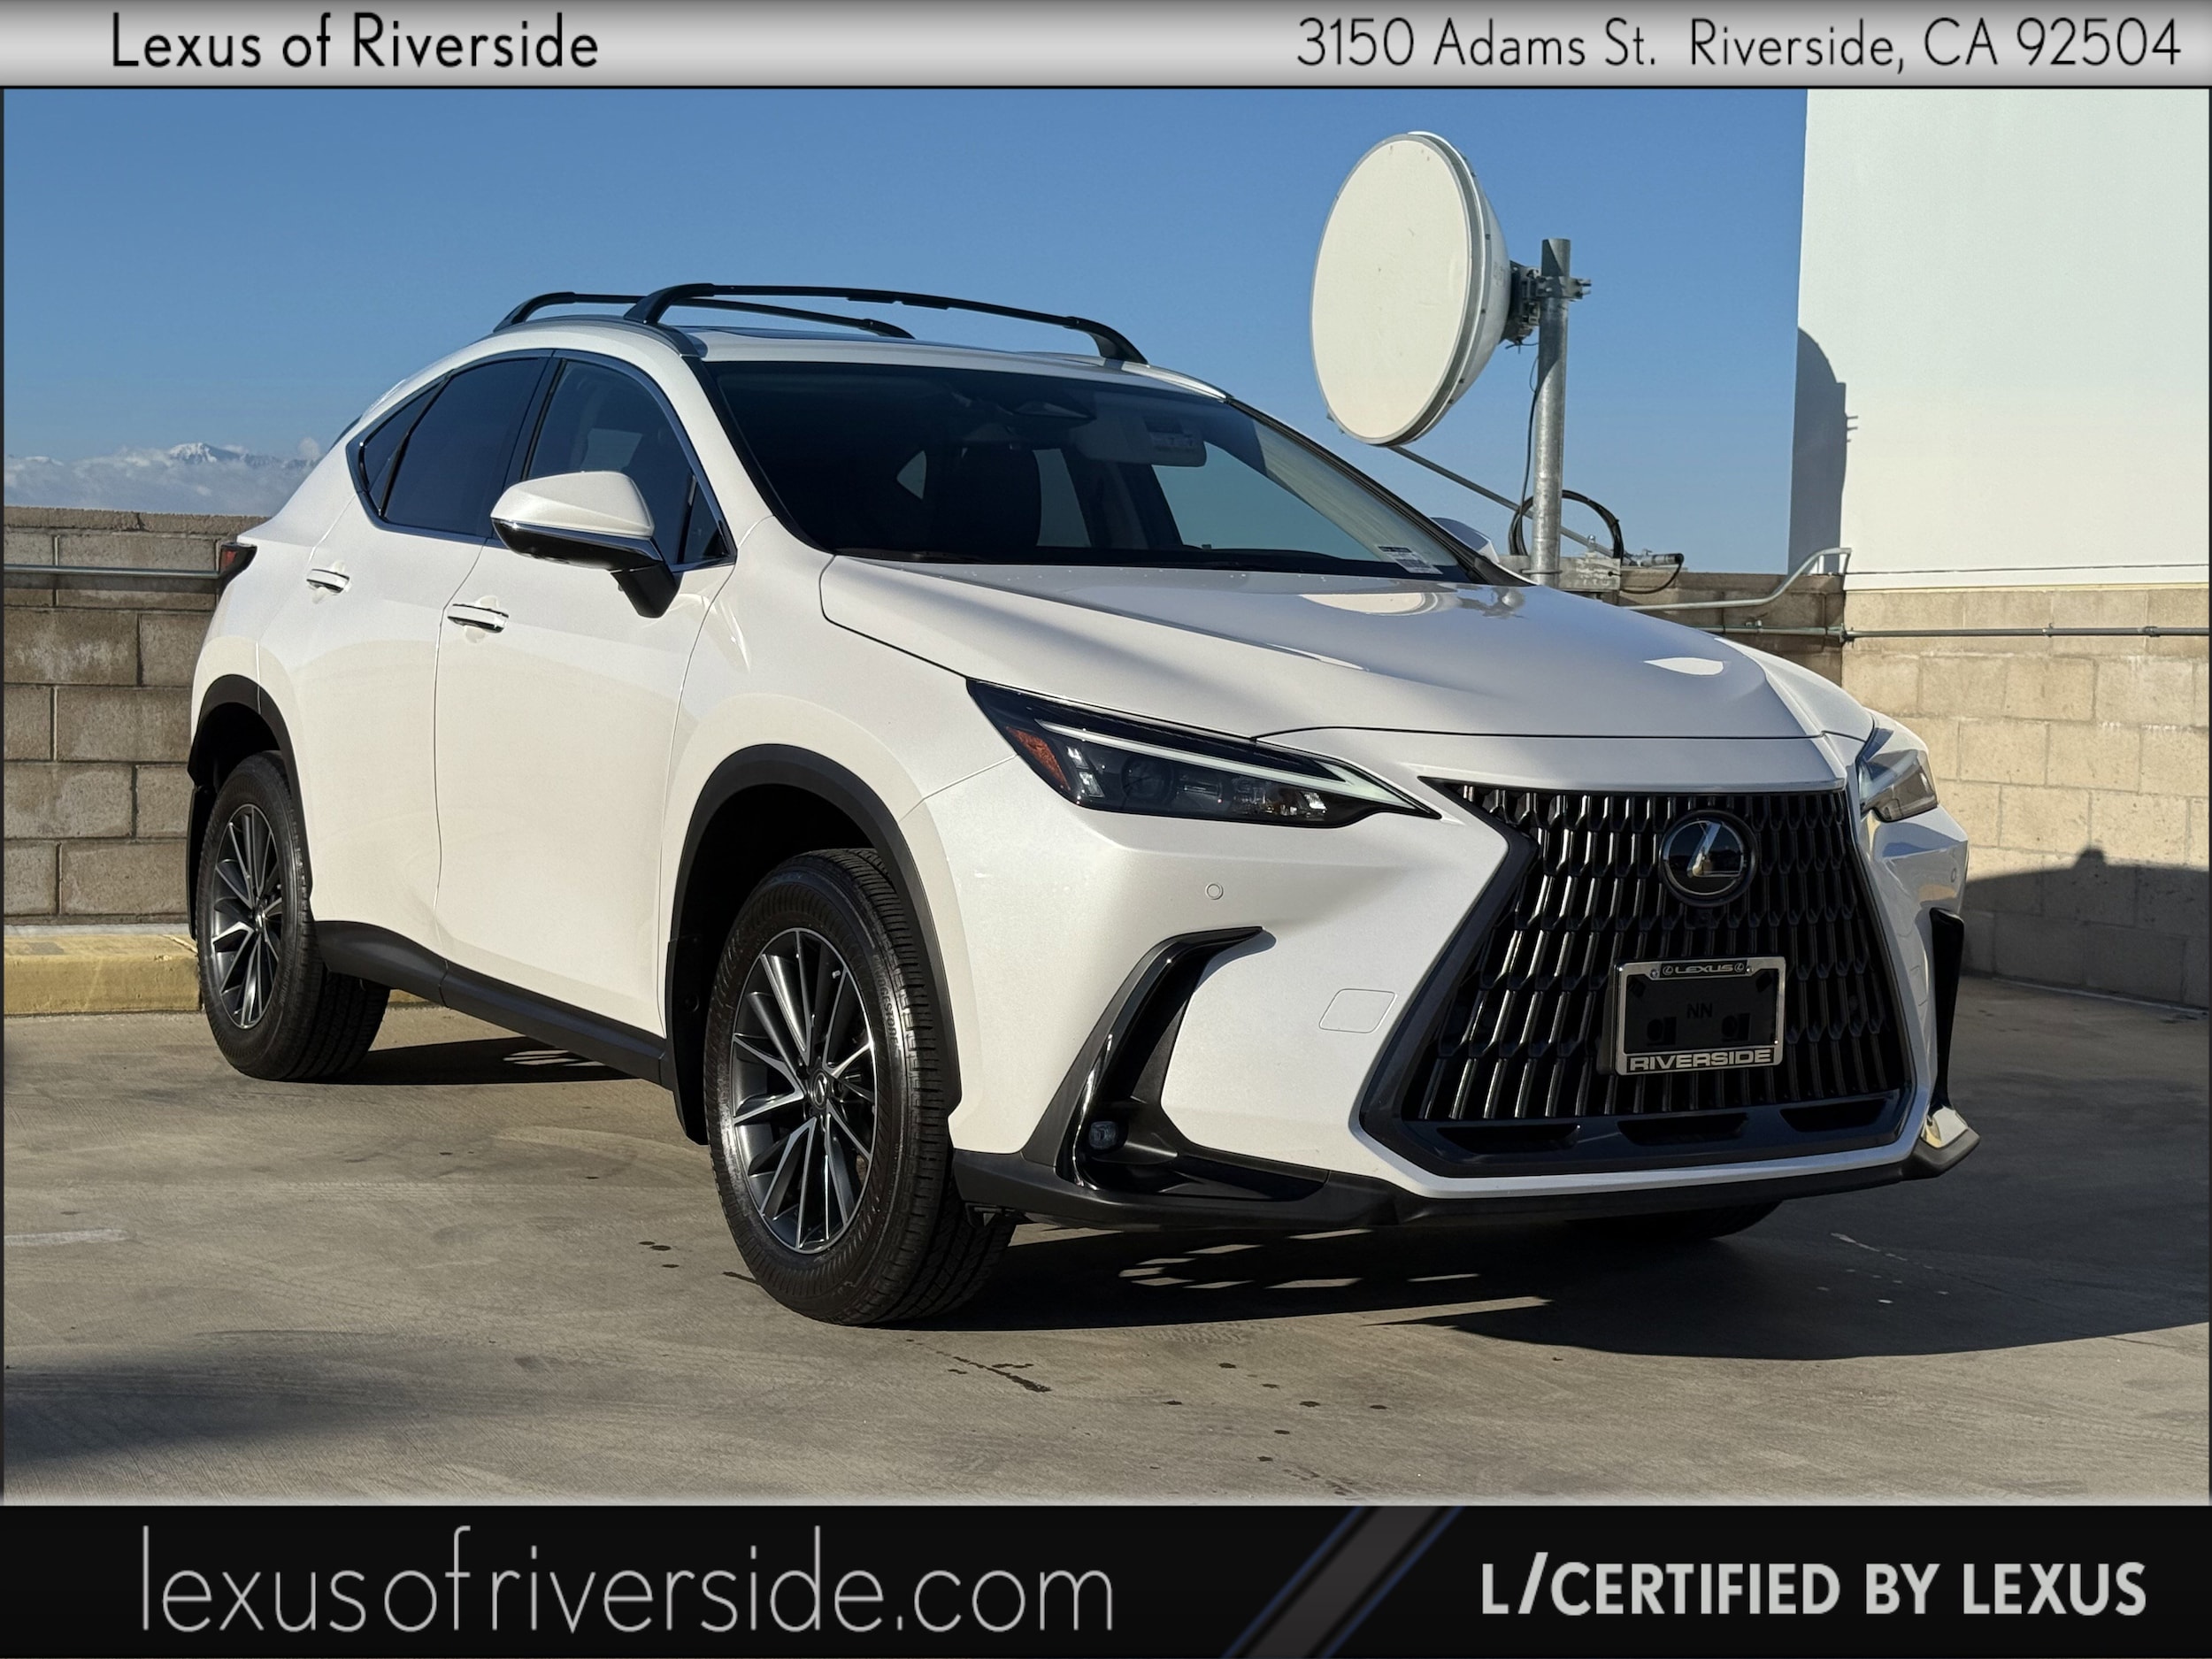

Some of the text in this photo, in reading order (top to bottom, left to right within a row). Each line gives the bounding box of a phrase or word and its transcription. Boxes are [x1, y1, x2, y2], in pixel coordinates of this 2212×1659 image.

[1675, 964, 1733, 974] LEXUS
[1687, 1002, 1713, 1018] NN
[1630, 1048, 1771, 1071] RIVERSIDE
